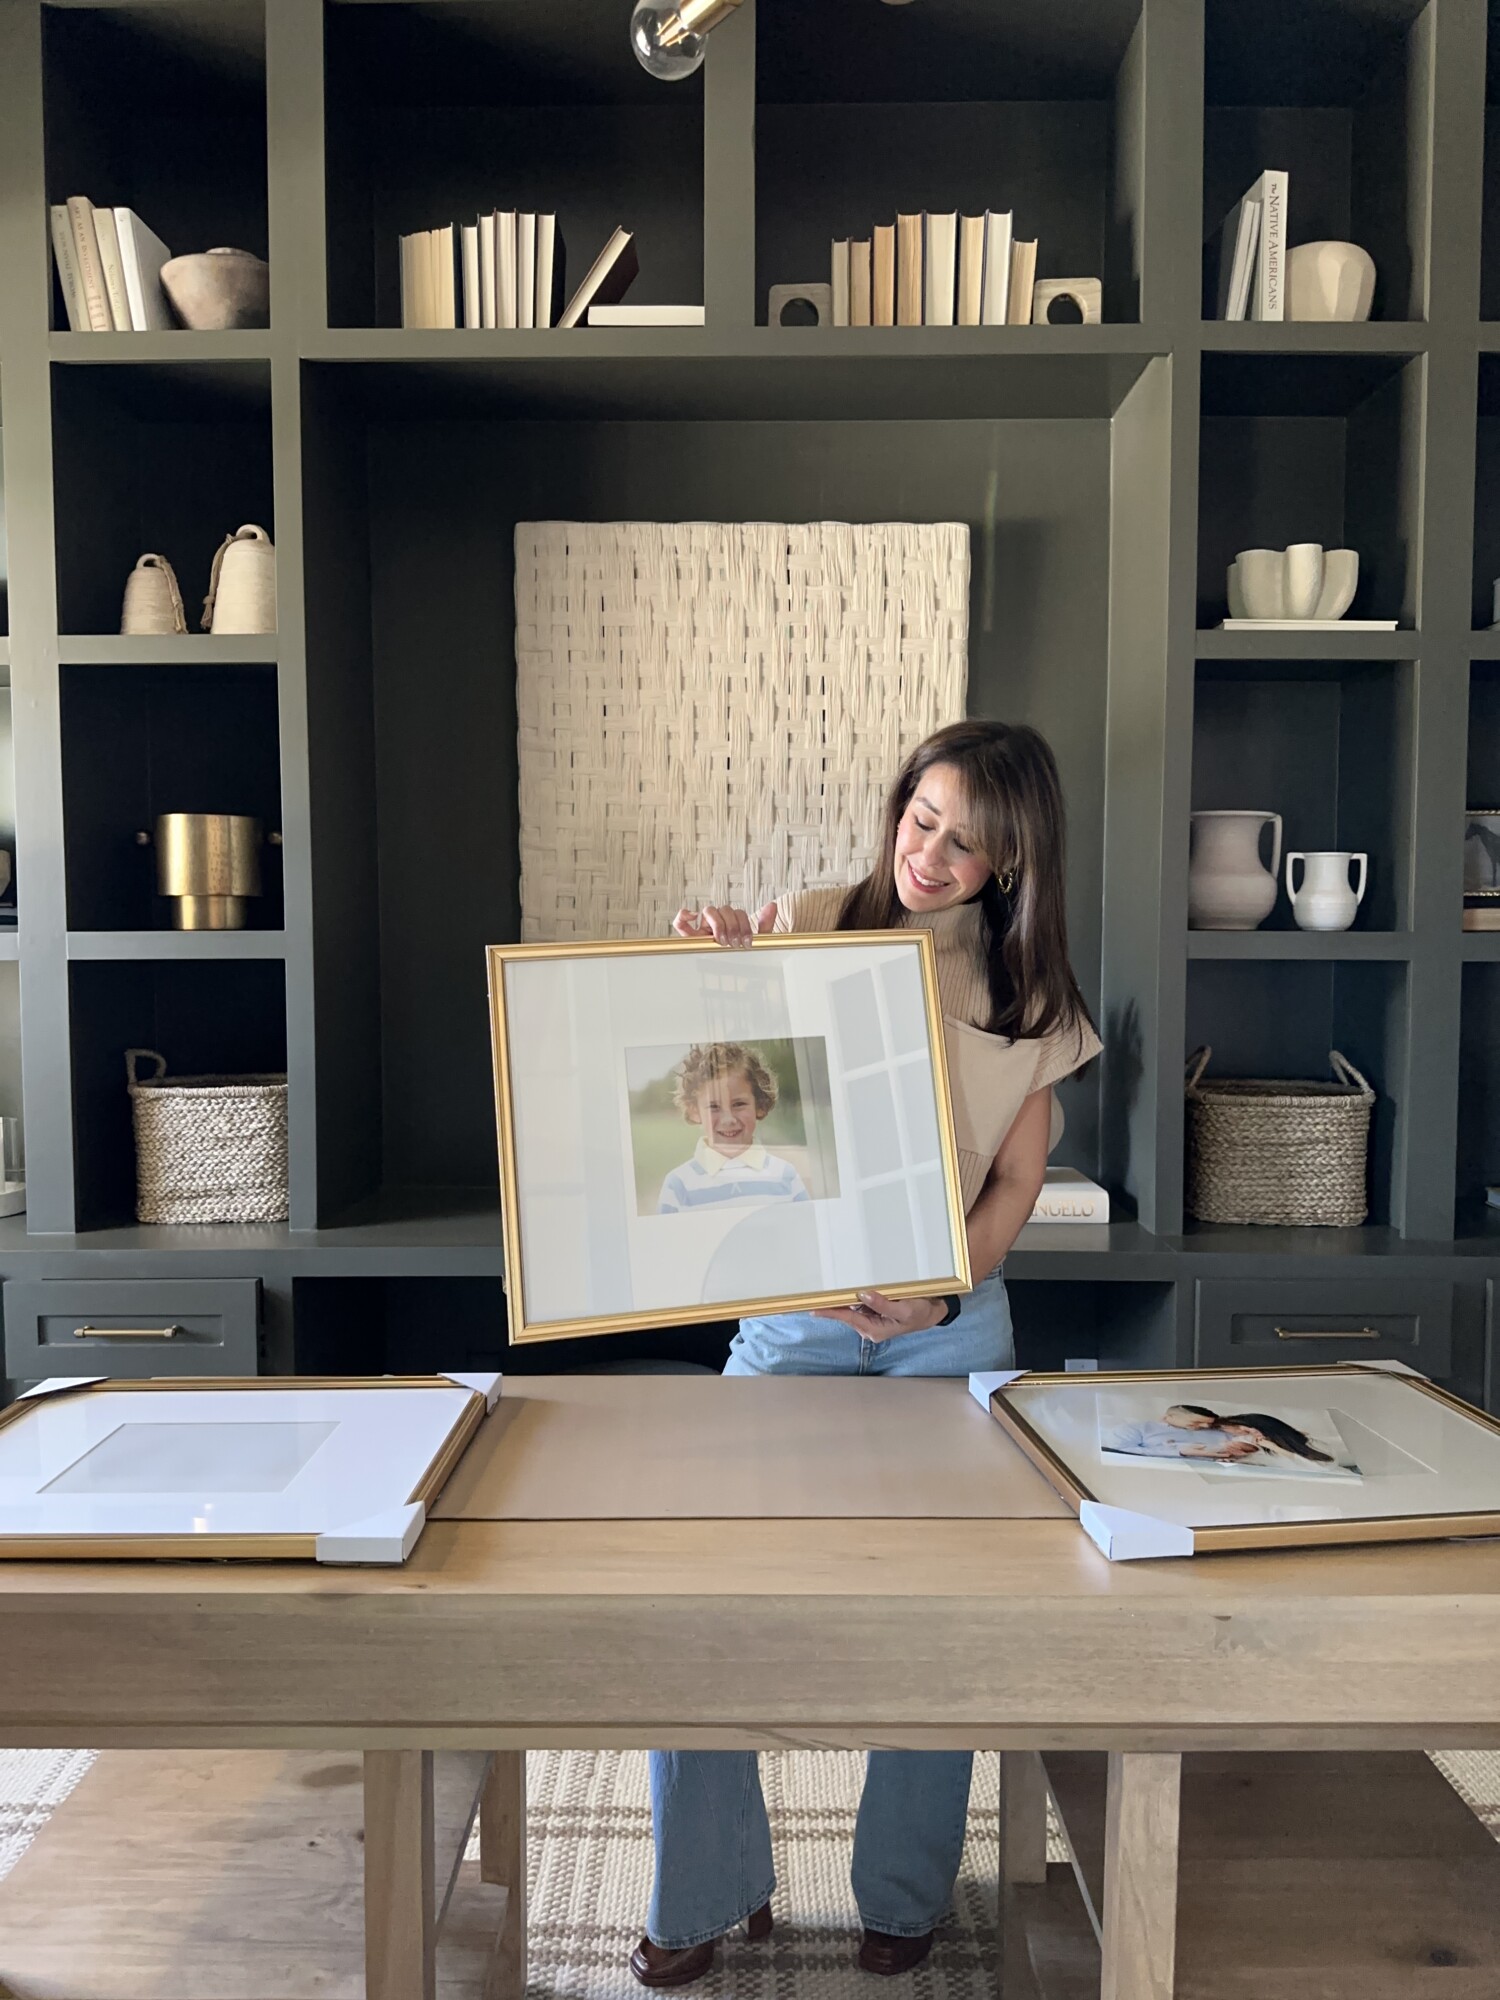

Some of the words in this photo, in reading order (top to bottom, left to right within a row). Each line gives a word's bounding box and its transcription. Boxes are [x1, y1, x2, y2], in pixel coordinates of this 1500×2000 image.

[1269, 195, 1279, 238] NATIVE
[1269, 240, 1278, 310] AMERICANS
[1032, 1200, 1095, 1217] NGELO
